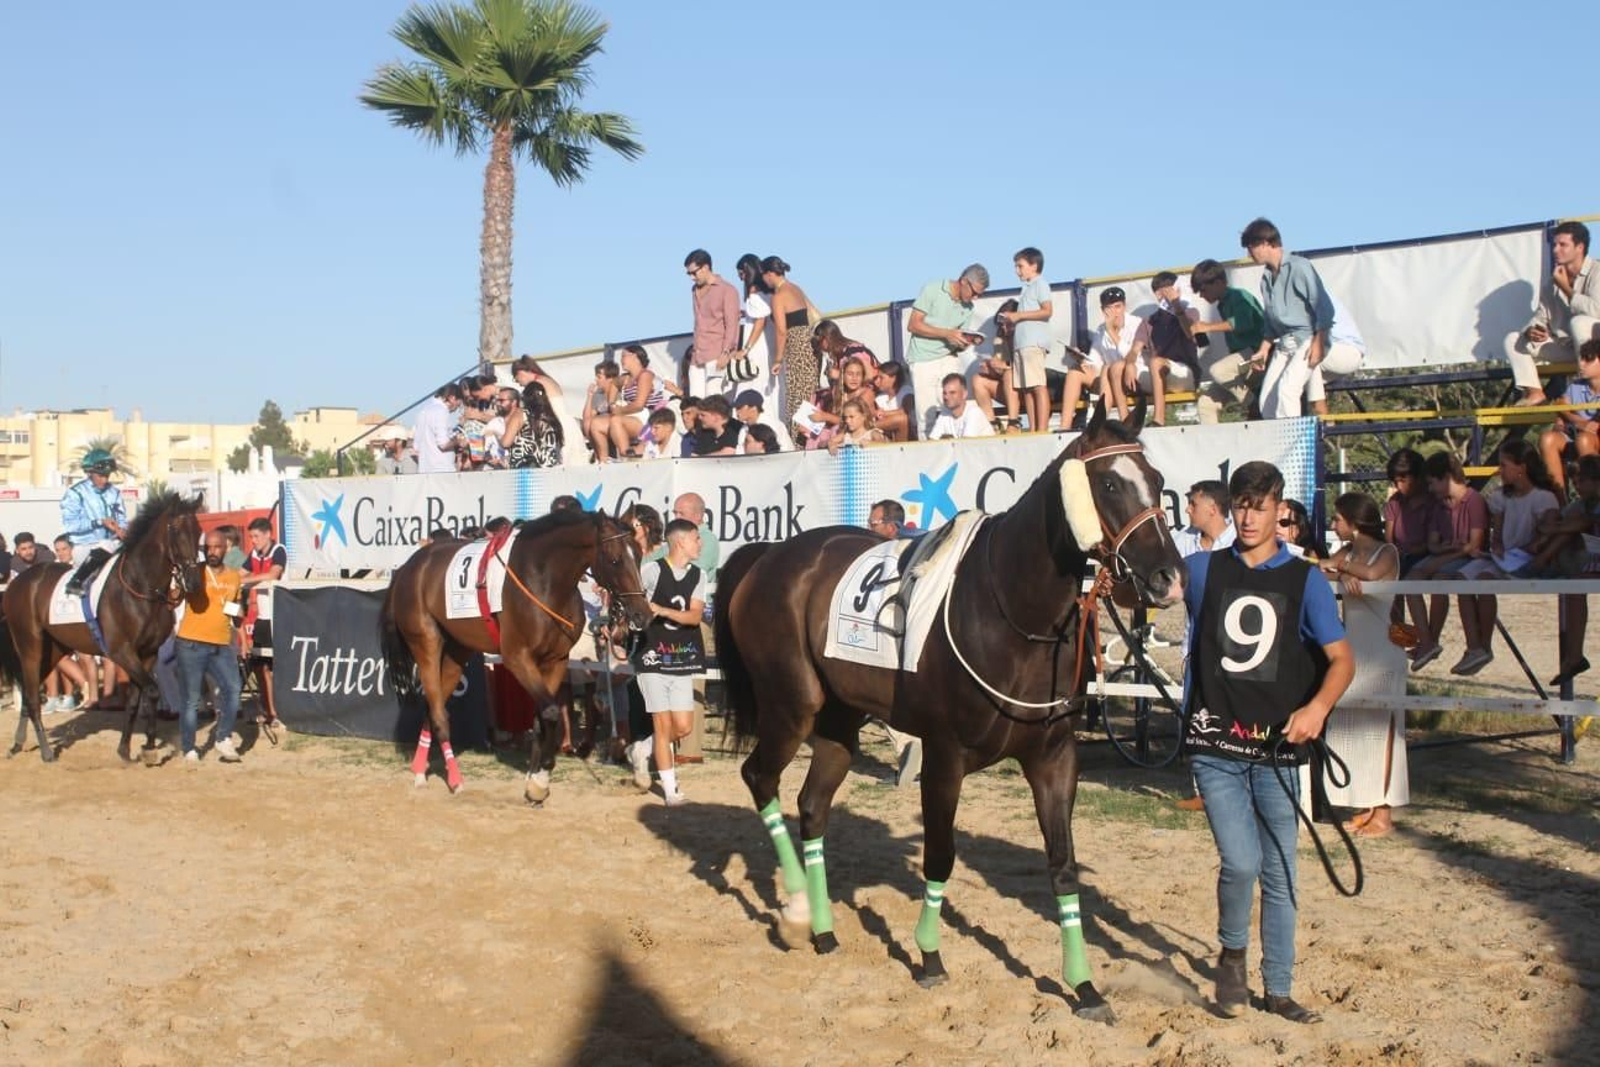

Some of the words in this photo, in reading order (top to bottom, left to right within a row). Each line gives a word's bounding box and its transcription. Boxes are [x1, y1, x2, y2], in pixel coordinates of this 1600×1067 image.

[458, 556, 473, 589] 3
[853, 561, 886, 613] 9
[1220, 595, 1278, 673] 9
